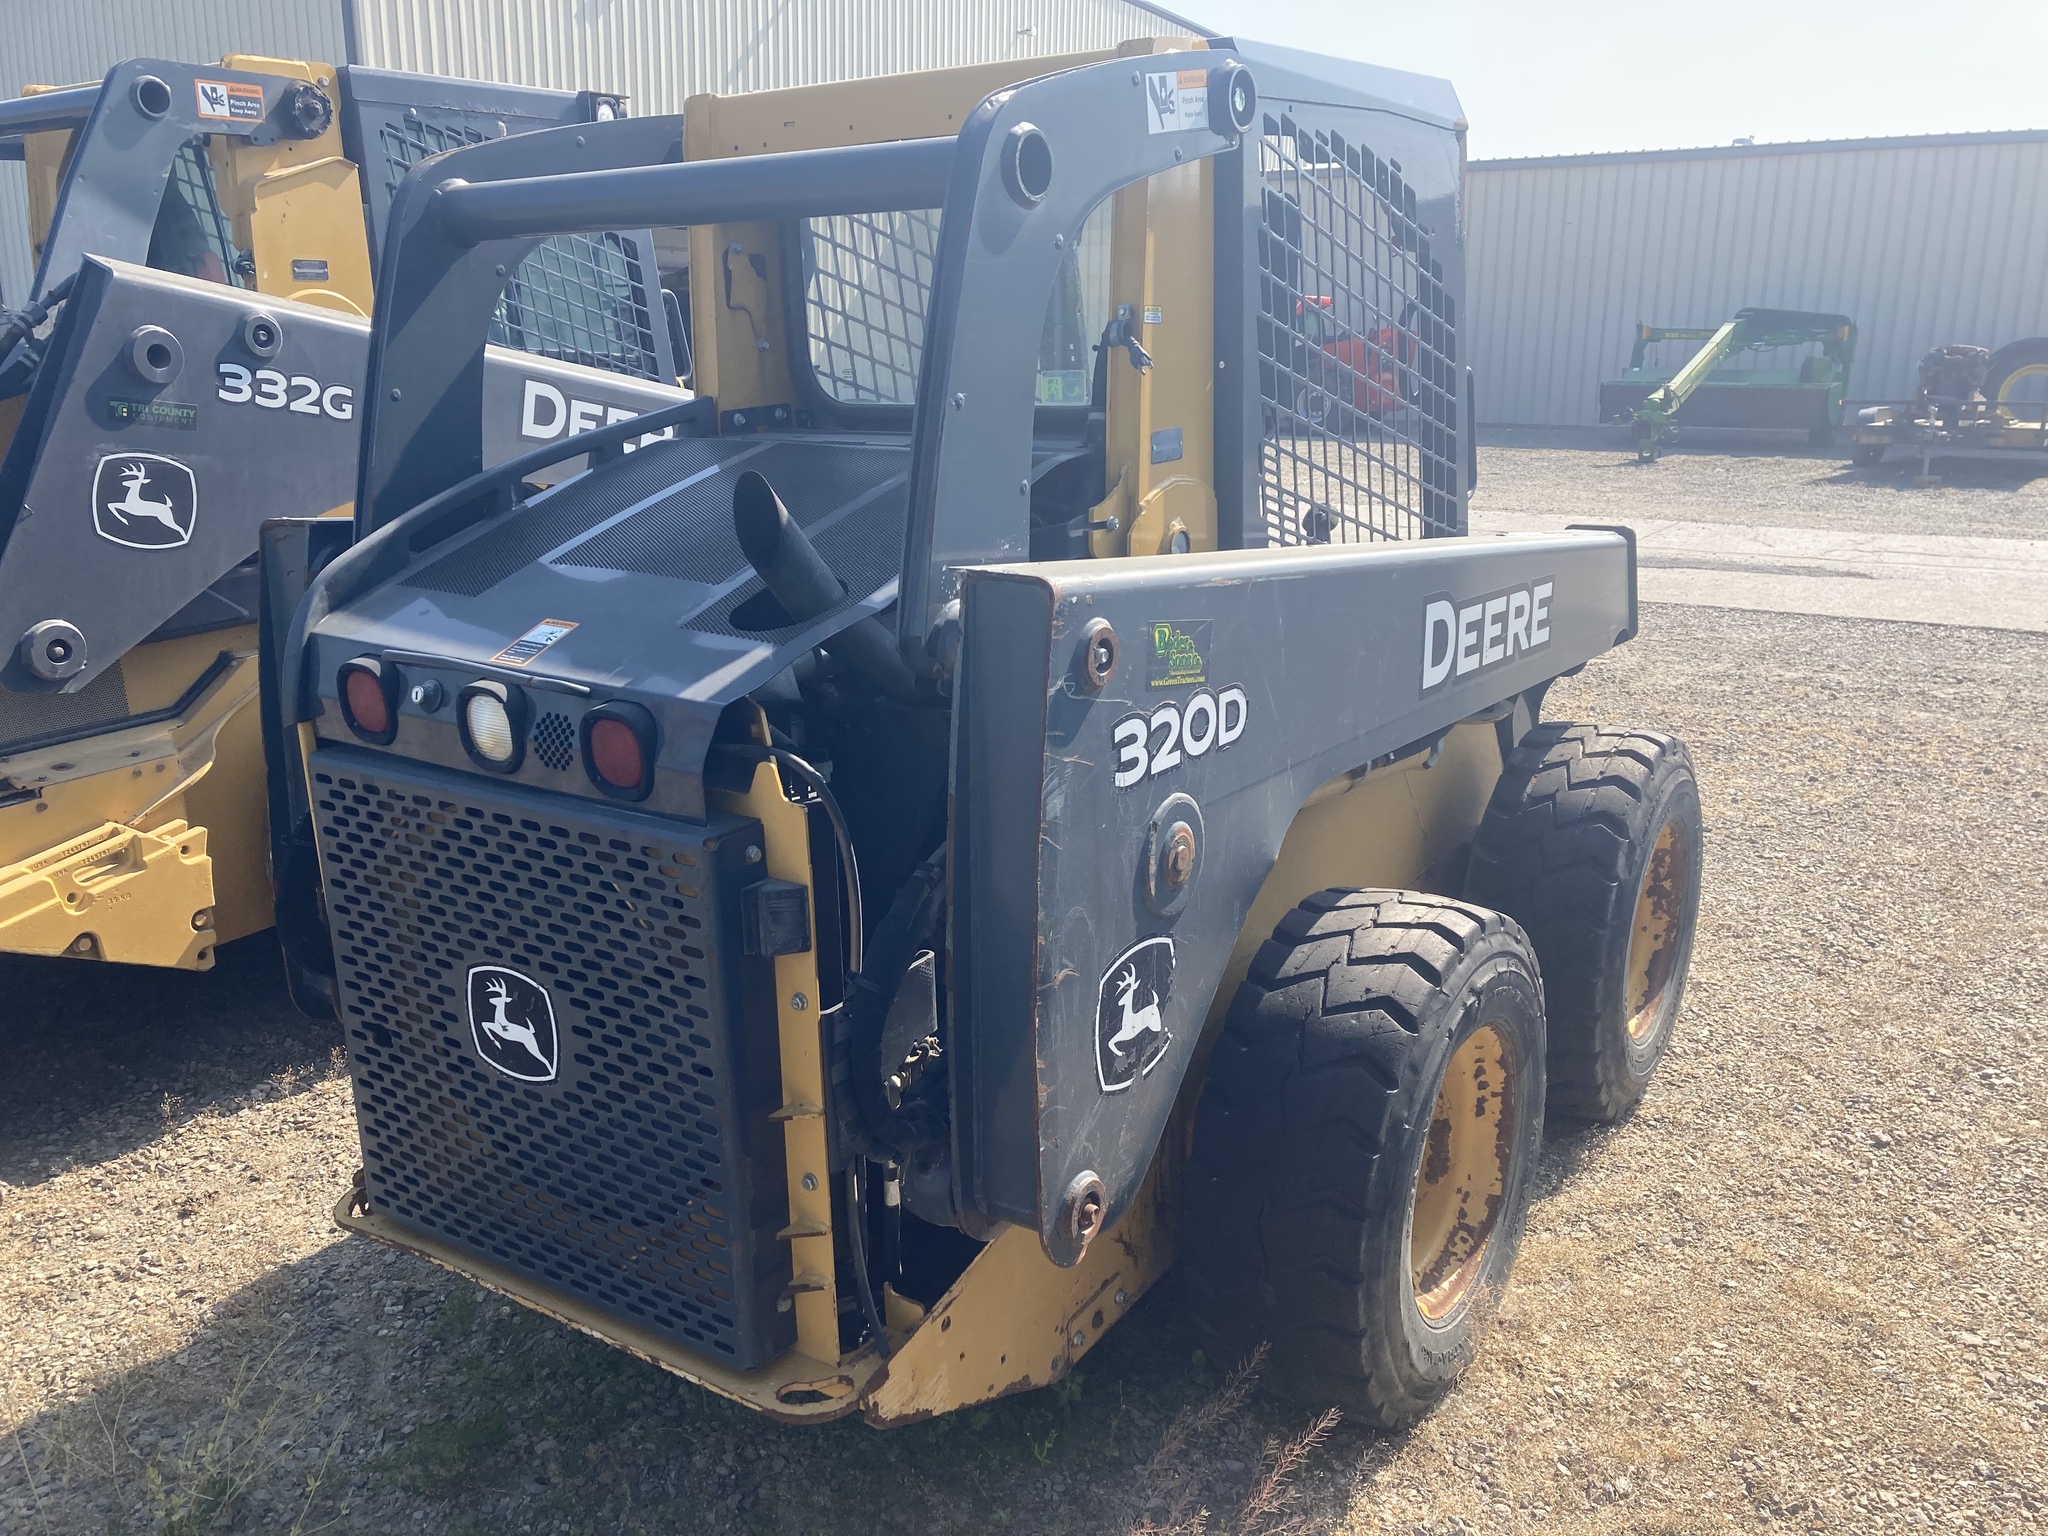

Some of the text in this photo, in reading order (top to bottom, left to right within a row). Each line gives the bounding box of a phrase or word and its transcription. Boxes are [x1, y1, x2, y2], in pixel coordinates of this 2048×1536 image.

[230, 99, 261, 109] Pinch Area
[1182, 95, 1205, 104] Pinch Area
[218, 363, 354, 420] 332G
[130, 402, 197, 418] TRI COUNTY
[132, 412, 195, 425] EQUIPMENT
[1423, 582, 1553, 690] DEERE
[1114, 689, 1247, 788] 320D
